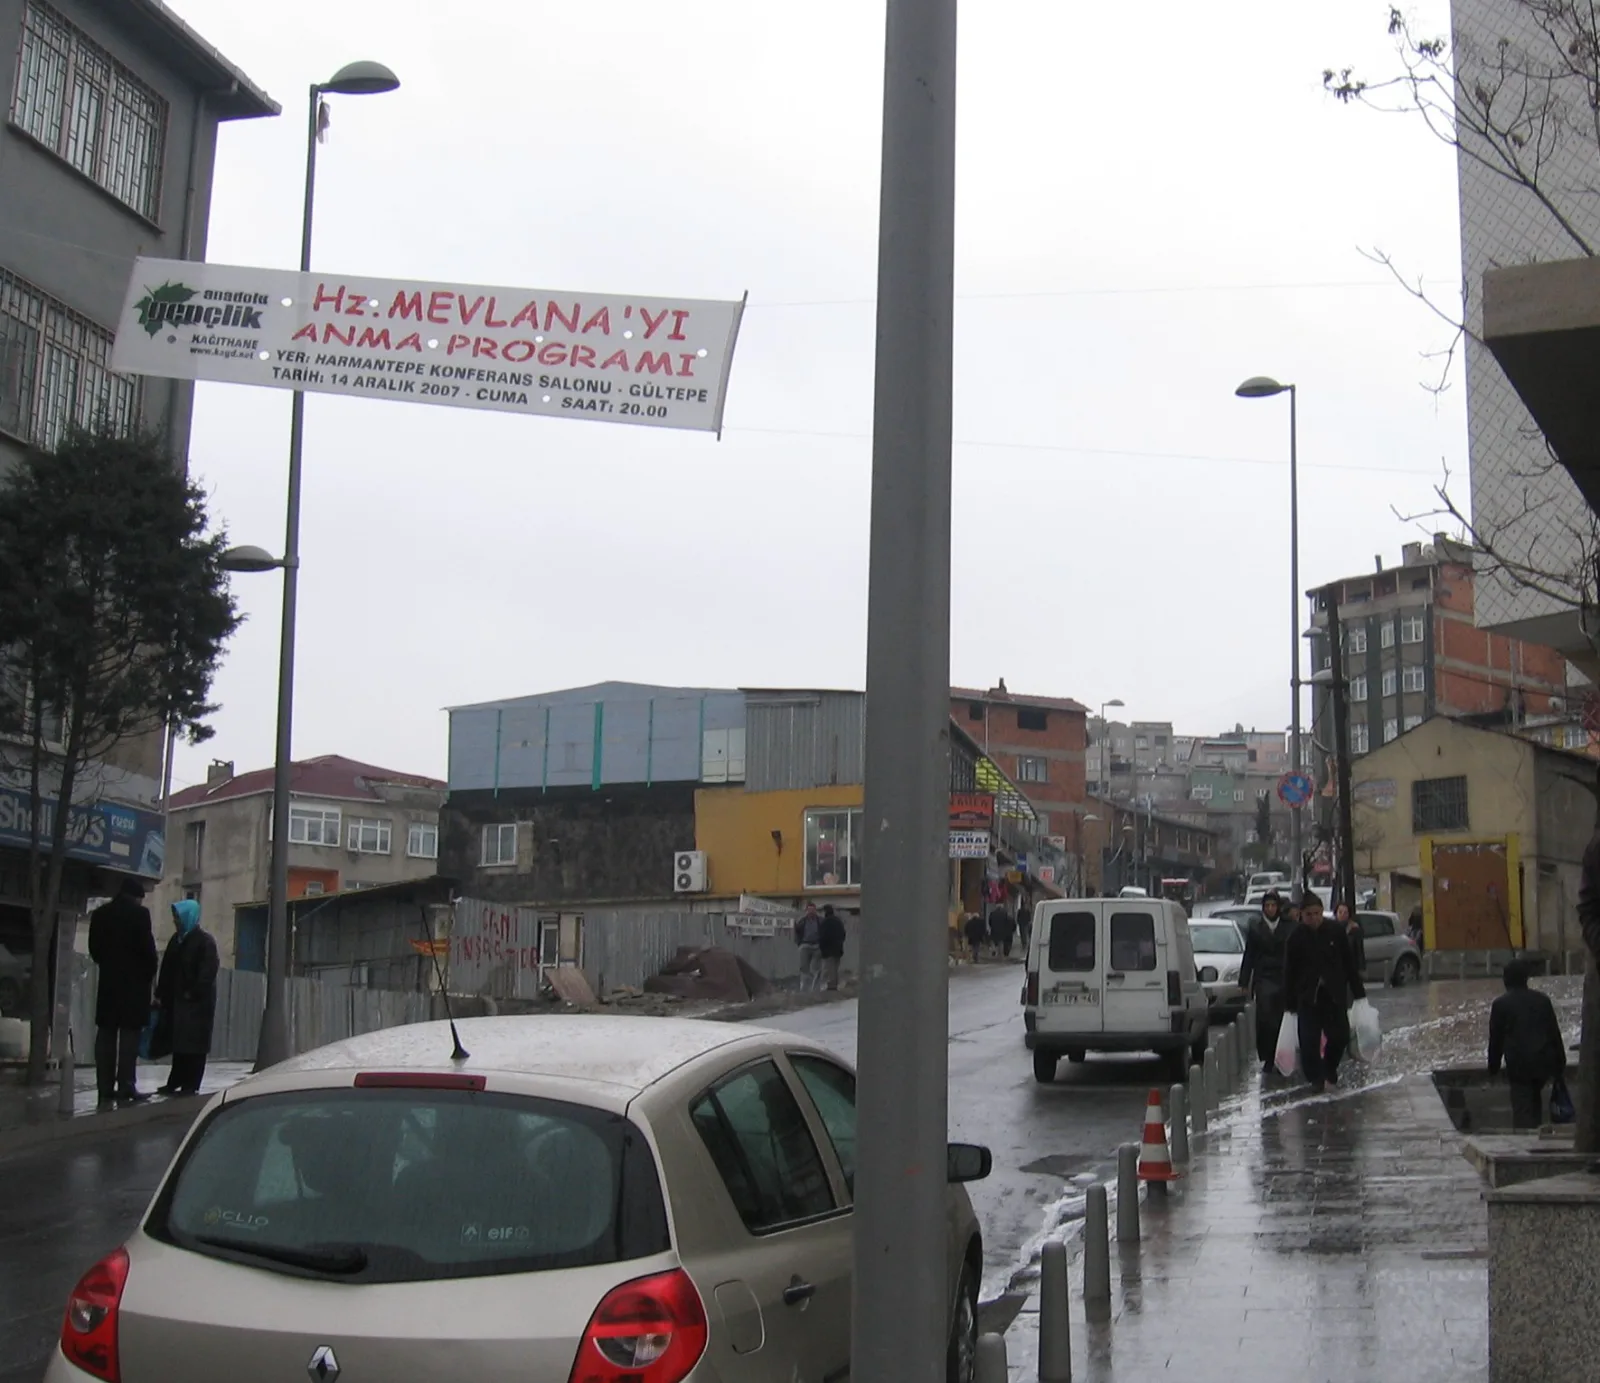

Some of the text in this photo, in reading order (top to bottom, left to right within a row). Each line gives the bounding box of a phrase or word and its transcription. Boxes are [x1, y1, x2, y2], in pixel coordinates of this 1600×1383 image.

[203, 288, 269, 305] anadolu
[148, 301, 264, 330] gençlik
[191, 333, 260, 351] KAĞITHANE
[291, 322, 697, 377] ANMA PROGRAMI
[276, 349, 311, 364] YER:
[315, 353, 425, 376] HARMANTEPE
[430, 362, 533, 387] KONFERANS
[539, 374, 612, 395] SALONU
[629, 381, 708, 402] GÜLTEPE
[272, 366, 325, 384] TARİH:
[330, 372, 350, 386] 14
[353, 375, 415, 394] ARALIK
[420, 382, 459, 398] 2007
[476, 388, 529, 406] CUMA
[561, 396, 614, 414] SAAT:
[619, 403, 668, 418] 20.00
[222, 1210, 269, 1227] CLIO
[488, 1226, 514, 1241] elf
